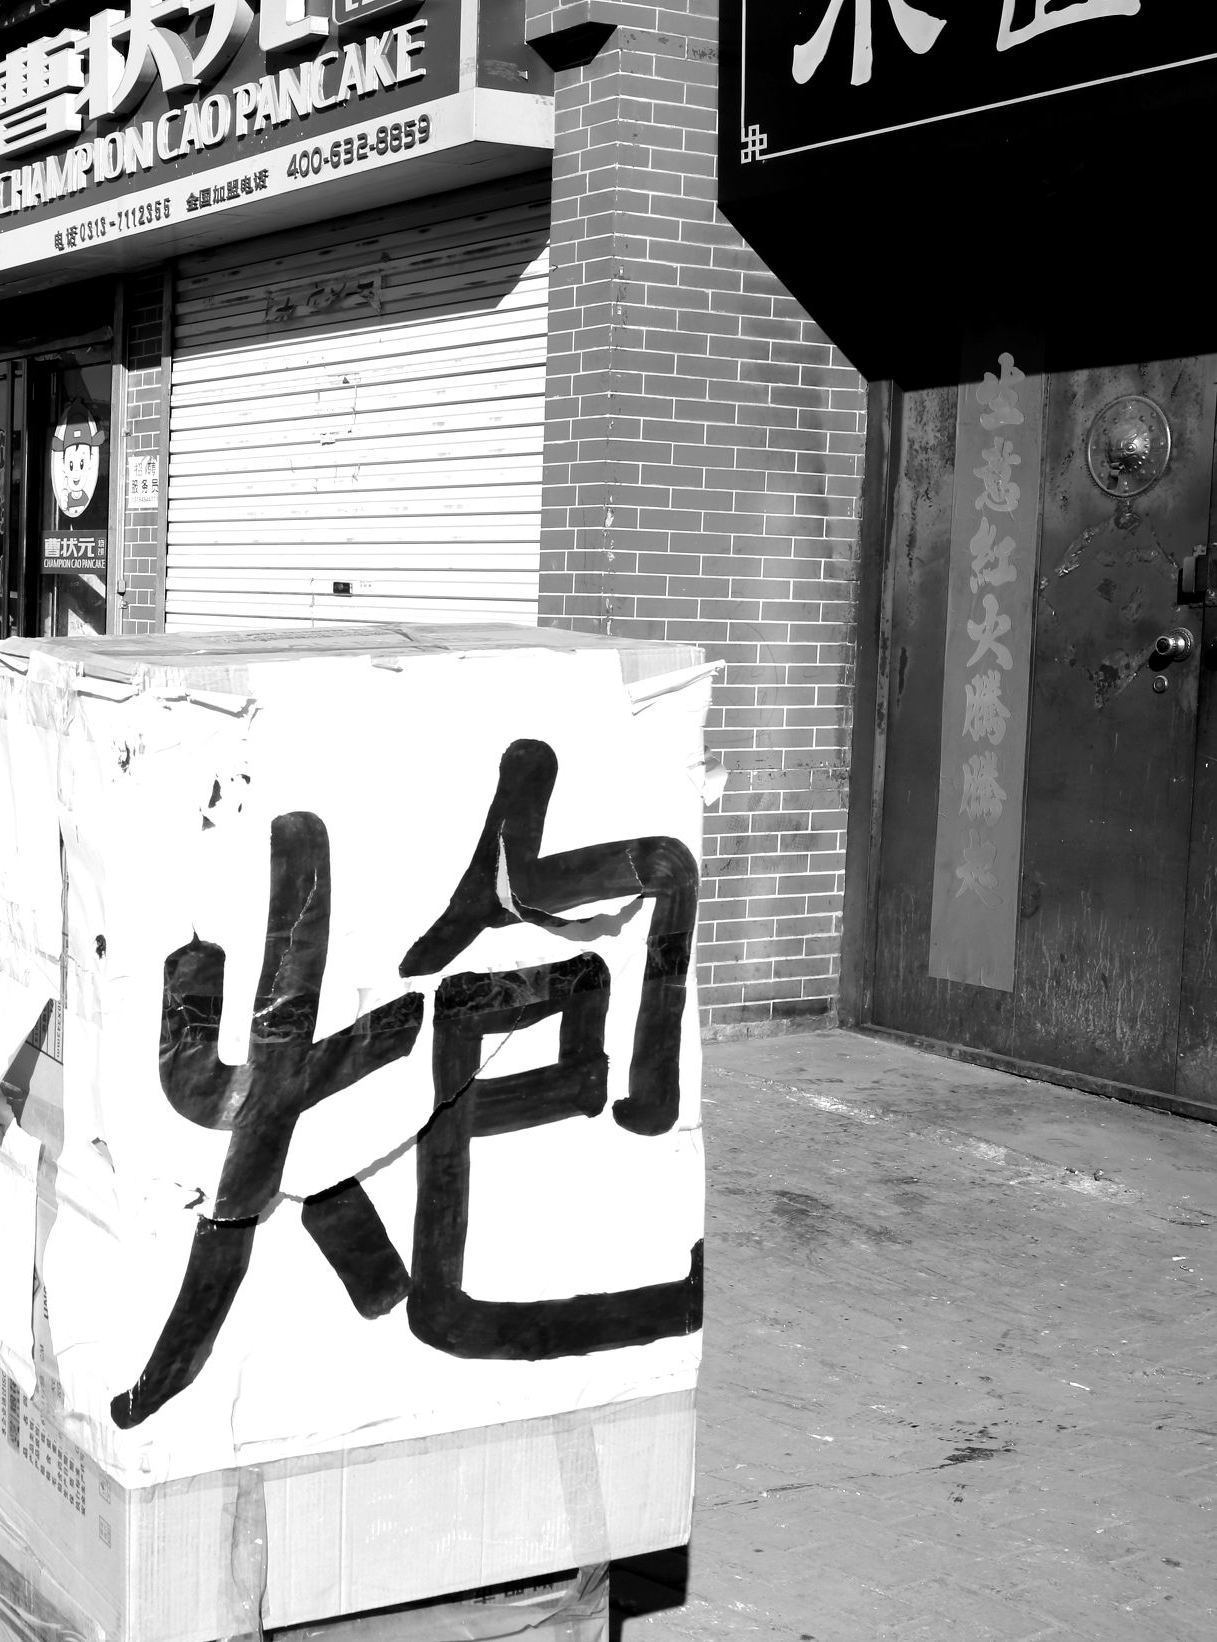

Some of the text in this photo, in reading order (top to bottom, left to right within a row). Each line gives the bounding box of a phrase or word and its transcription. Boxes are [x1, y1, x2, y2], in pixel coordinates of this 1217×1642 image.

[156, 92, 231, 158] CAO
[235, 18, 429, 136] PANCAKE
[185, 168, 269, 213] 全国加盟电话
[285, 112, 431, 180] 400-632-8859
[44, 537, 96, 558] 曹状元
[109, 738, 704, 1430] 炮
